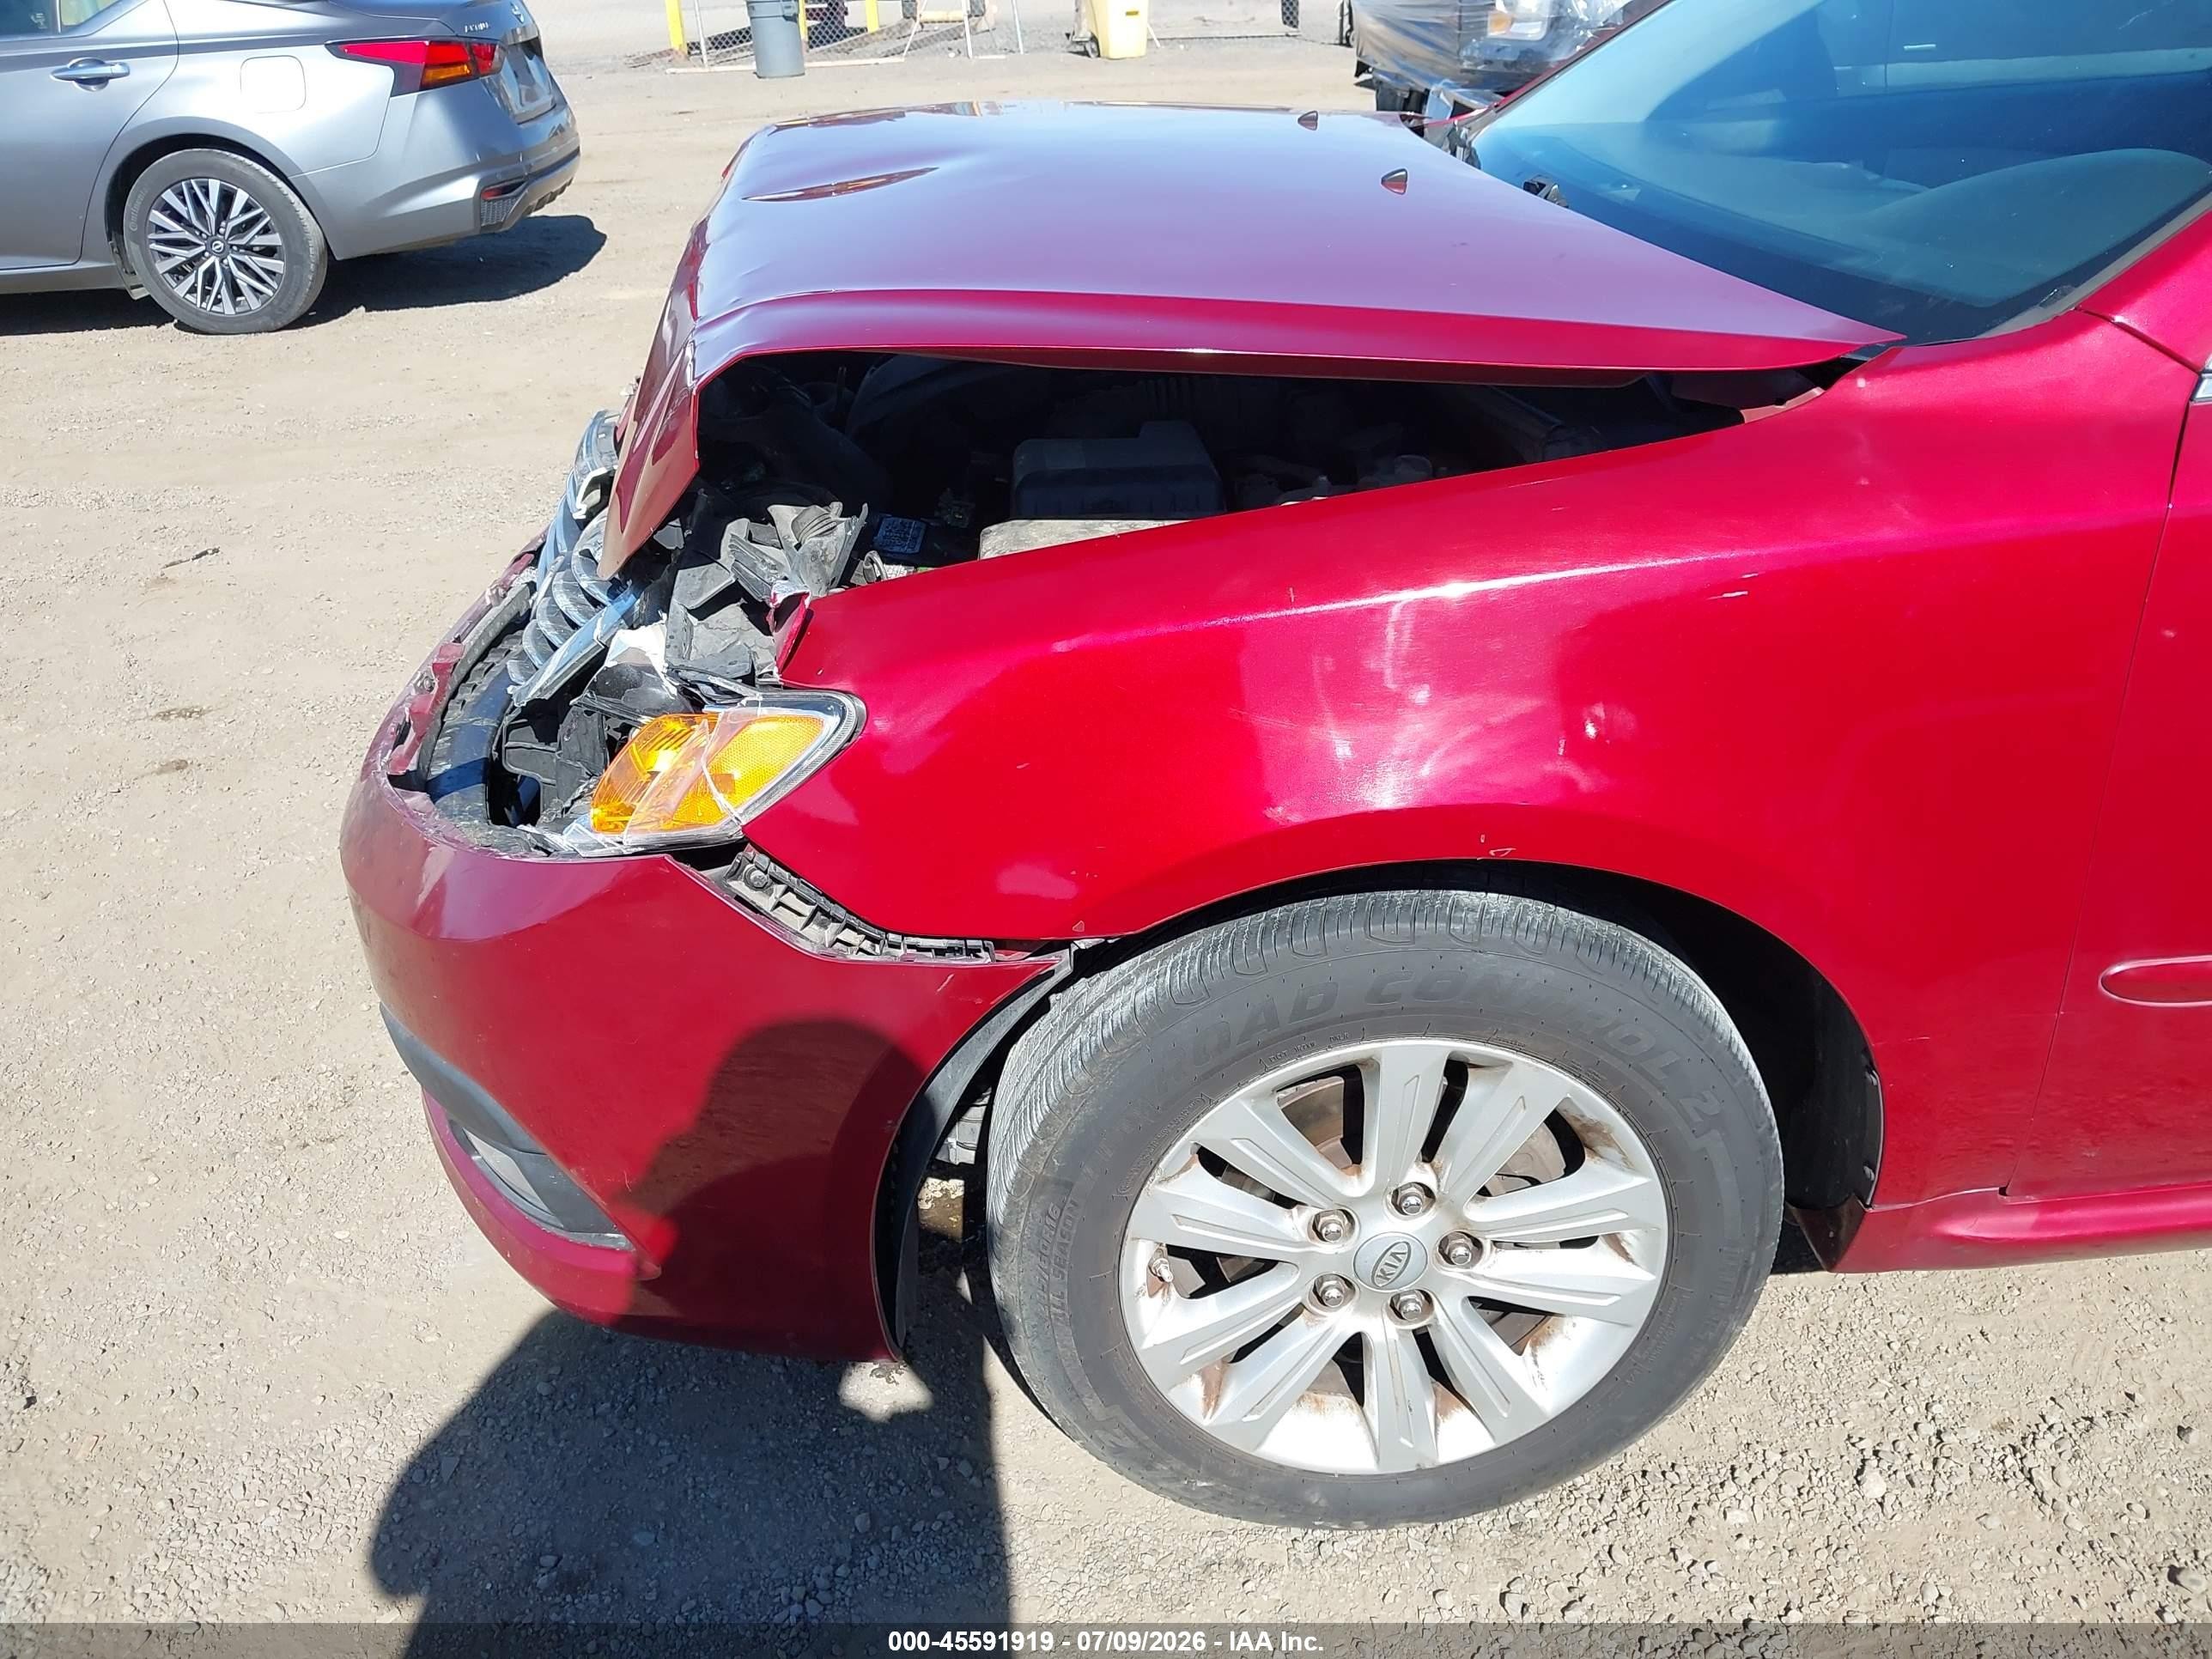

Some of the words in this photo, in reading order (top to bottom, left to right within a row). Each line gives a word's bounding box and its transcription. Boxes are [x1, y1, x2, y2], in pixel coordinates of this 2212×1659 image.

[1680, 1090, 1723, 1123] 2
[1053, 1198, 1079, 1280] SEASON
[1375, 1250, 1407, 1281] KIA
